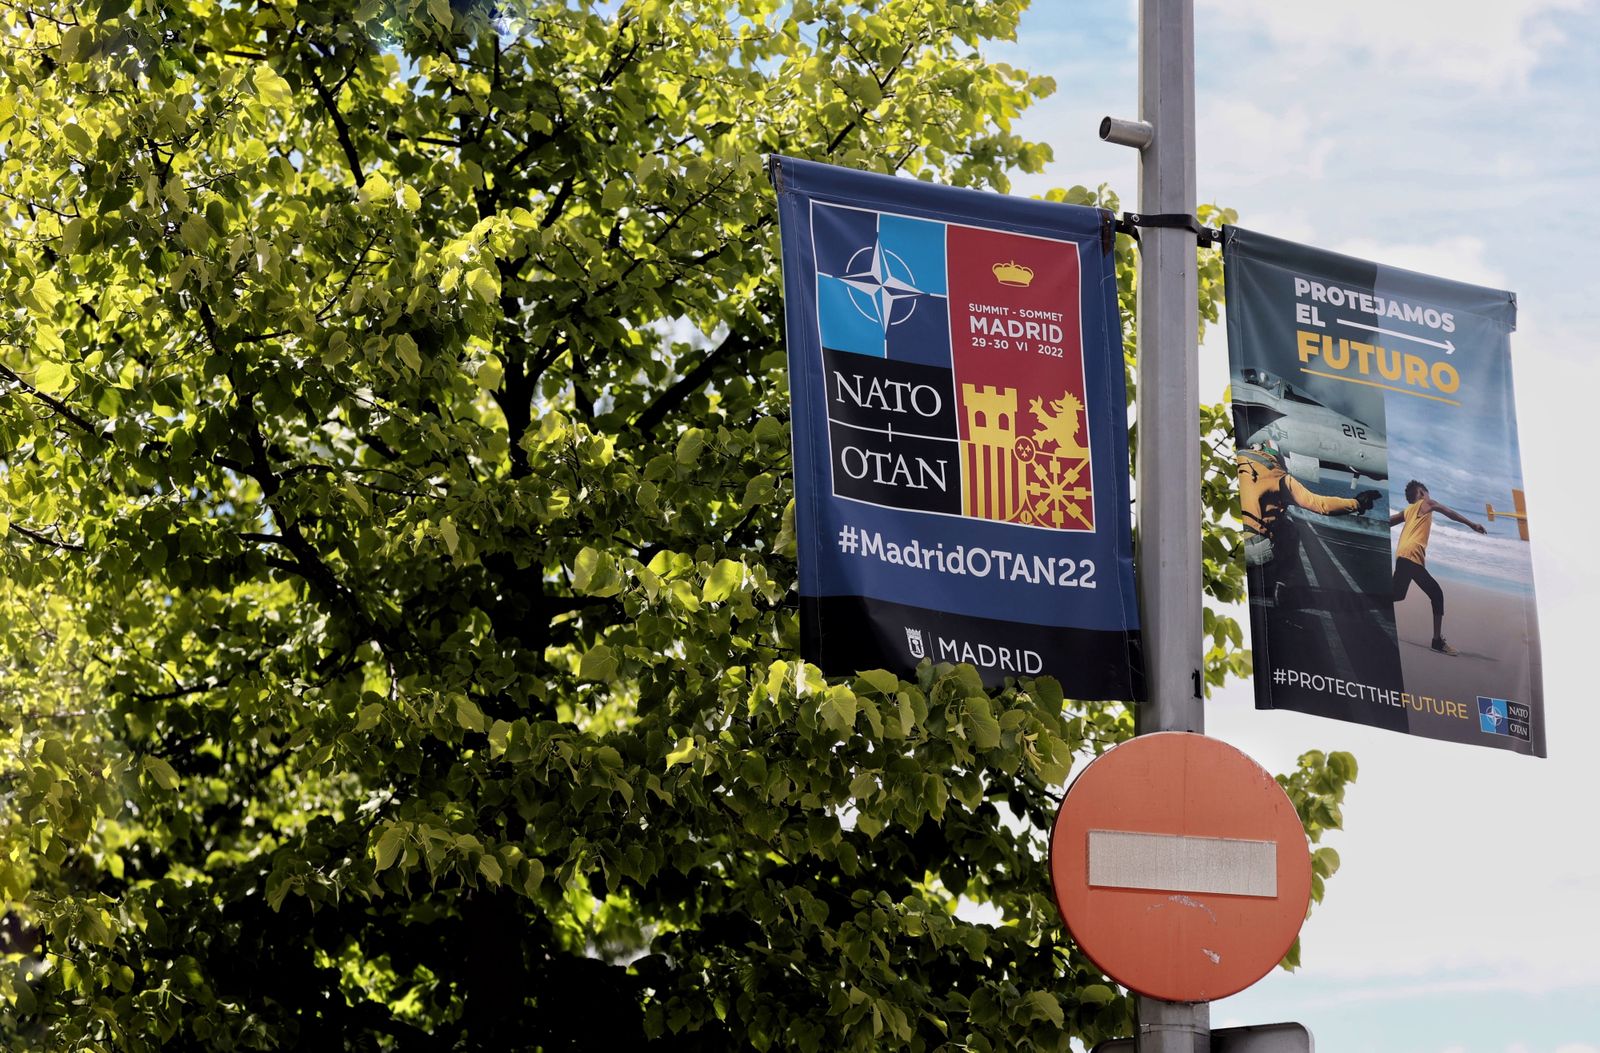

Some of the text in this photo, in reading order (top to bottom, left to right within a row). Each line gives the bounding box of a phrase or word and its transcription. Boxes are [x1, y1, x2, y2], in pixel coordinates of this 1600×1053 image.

[968, 303, 1009, 316] SUMMIT
[1019, 309, 1063, 322] SOMMET
[1294, 277, 1455, 333] PROTEJAMOS
[1295, 302, 1326, 328] EL
[969, 315, 1063, 344] MADRID
[972, 337, 1063, 358] 29-30 VI 2022
[1296, 330, 1461, 394] FUTURO
[833, 370, 942, 418] NATO
[1341, 423, 1367, 440] 212
[841, 446, 948, 492] OTAN
[838, 525, 1096, 588] #MadridOTAN22
[938, 637, 1043, 674] MADRID
[1273, 668, 1469, 720] #PROTECTTHEFUTURE
[1509, 705, 1529, 719] NATO
[1509, 723, 1528, 737] OTAN
